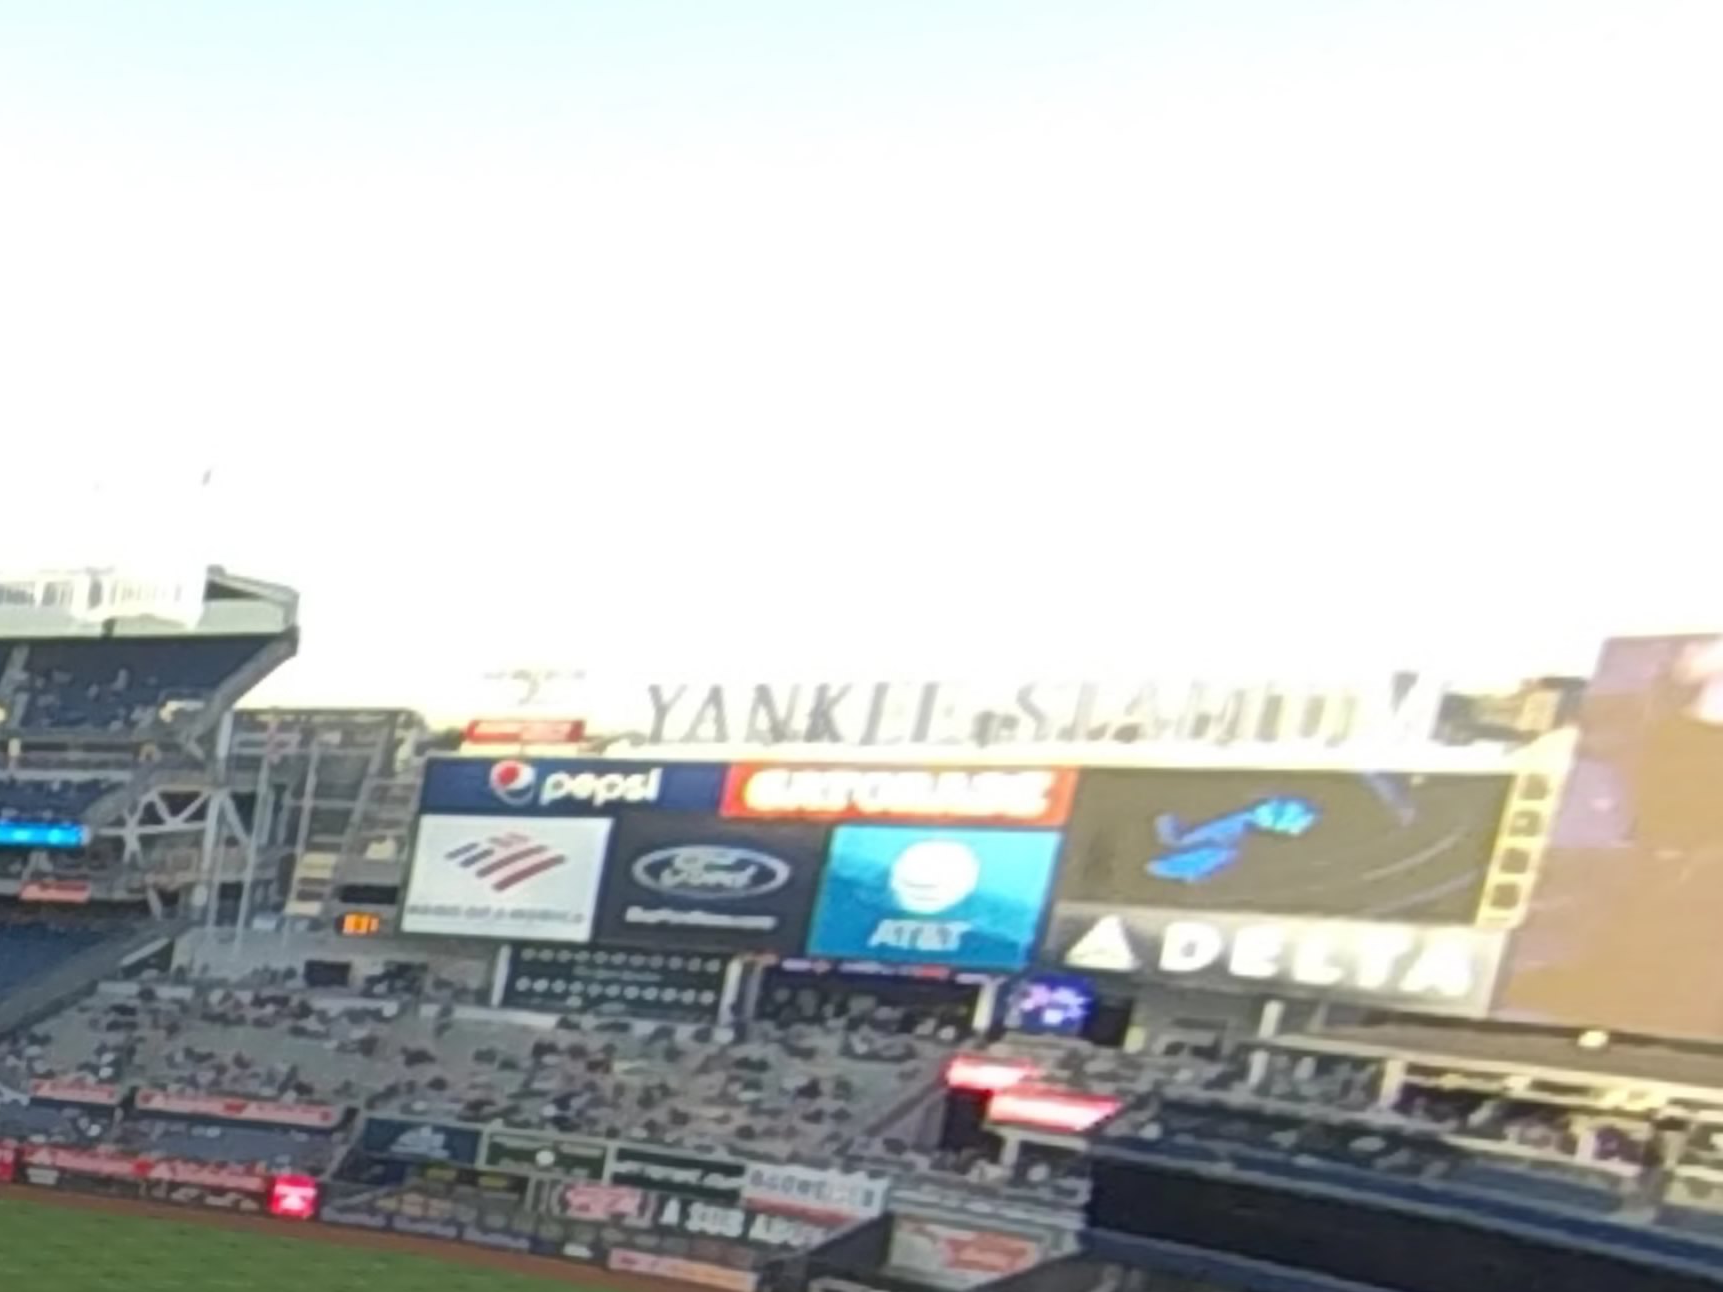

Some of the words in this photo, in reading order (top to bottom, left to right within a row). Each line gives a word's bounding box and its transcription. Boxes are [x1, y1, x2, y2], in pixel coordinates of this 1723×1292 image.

[539, 768, 663, 807] pepsi
[867, 918, 971, 951] AT&T
[1158, 919, 1473, 997] DELTA
